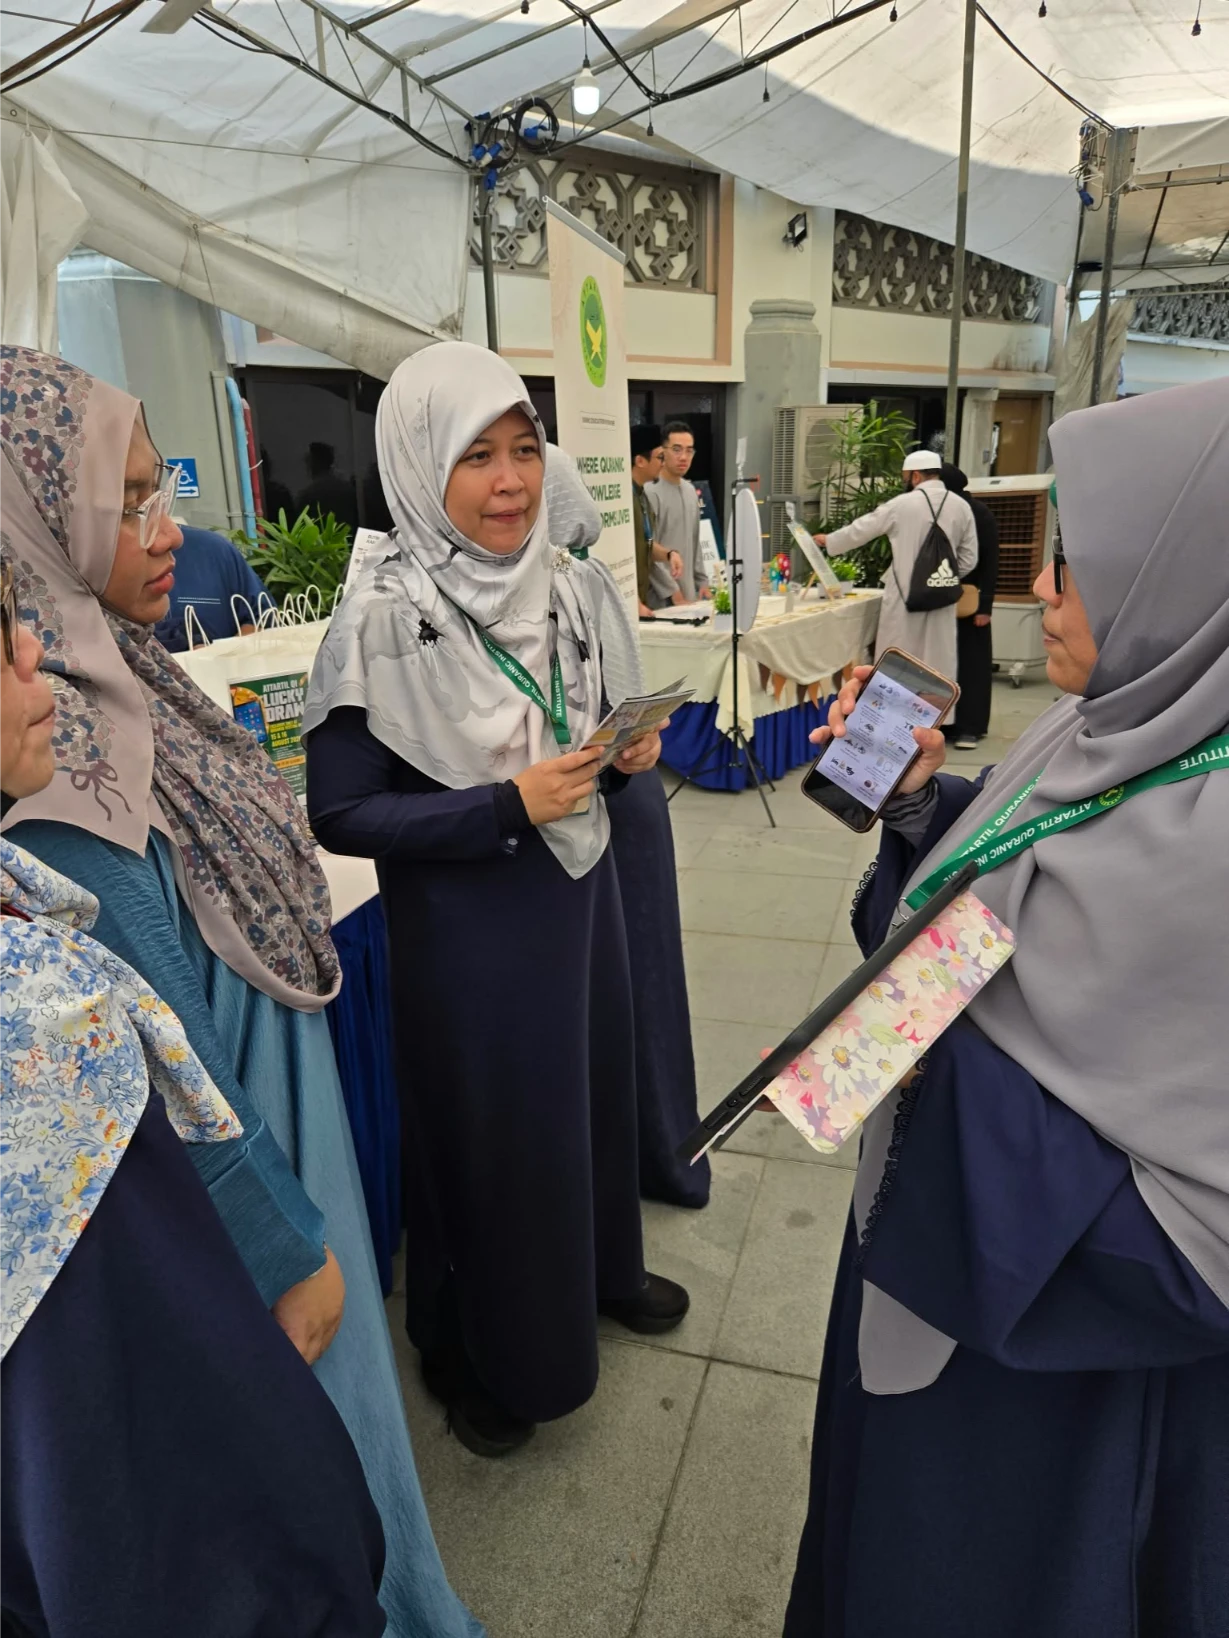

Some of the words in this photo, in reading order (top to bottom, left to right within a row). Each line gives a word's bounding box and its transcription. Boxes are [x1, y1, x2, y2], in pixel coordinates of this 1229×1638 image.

[576, 456, 599, 475] WHERE
[504, 660, 531, 688] QURANIC
[263, 687, 304, 708] LUCKY
[554, 680, 563, 718] INSTITUTE
[266, 701, 306, 723] DRAW
[272, 738, 290, 747] AUGUST
[1179, 745, 1229, 770] TITUTE
[994, 784, 1035, 826] QURANIC
[1037, 800, 1093, 830] ATTARTIL
[989, 827, 1036, 859] QURANIC
